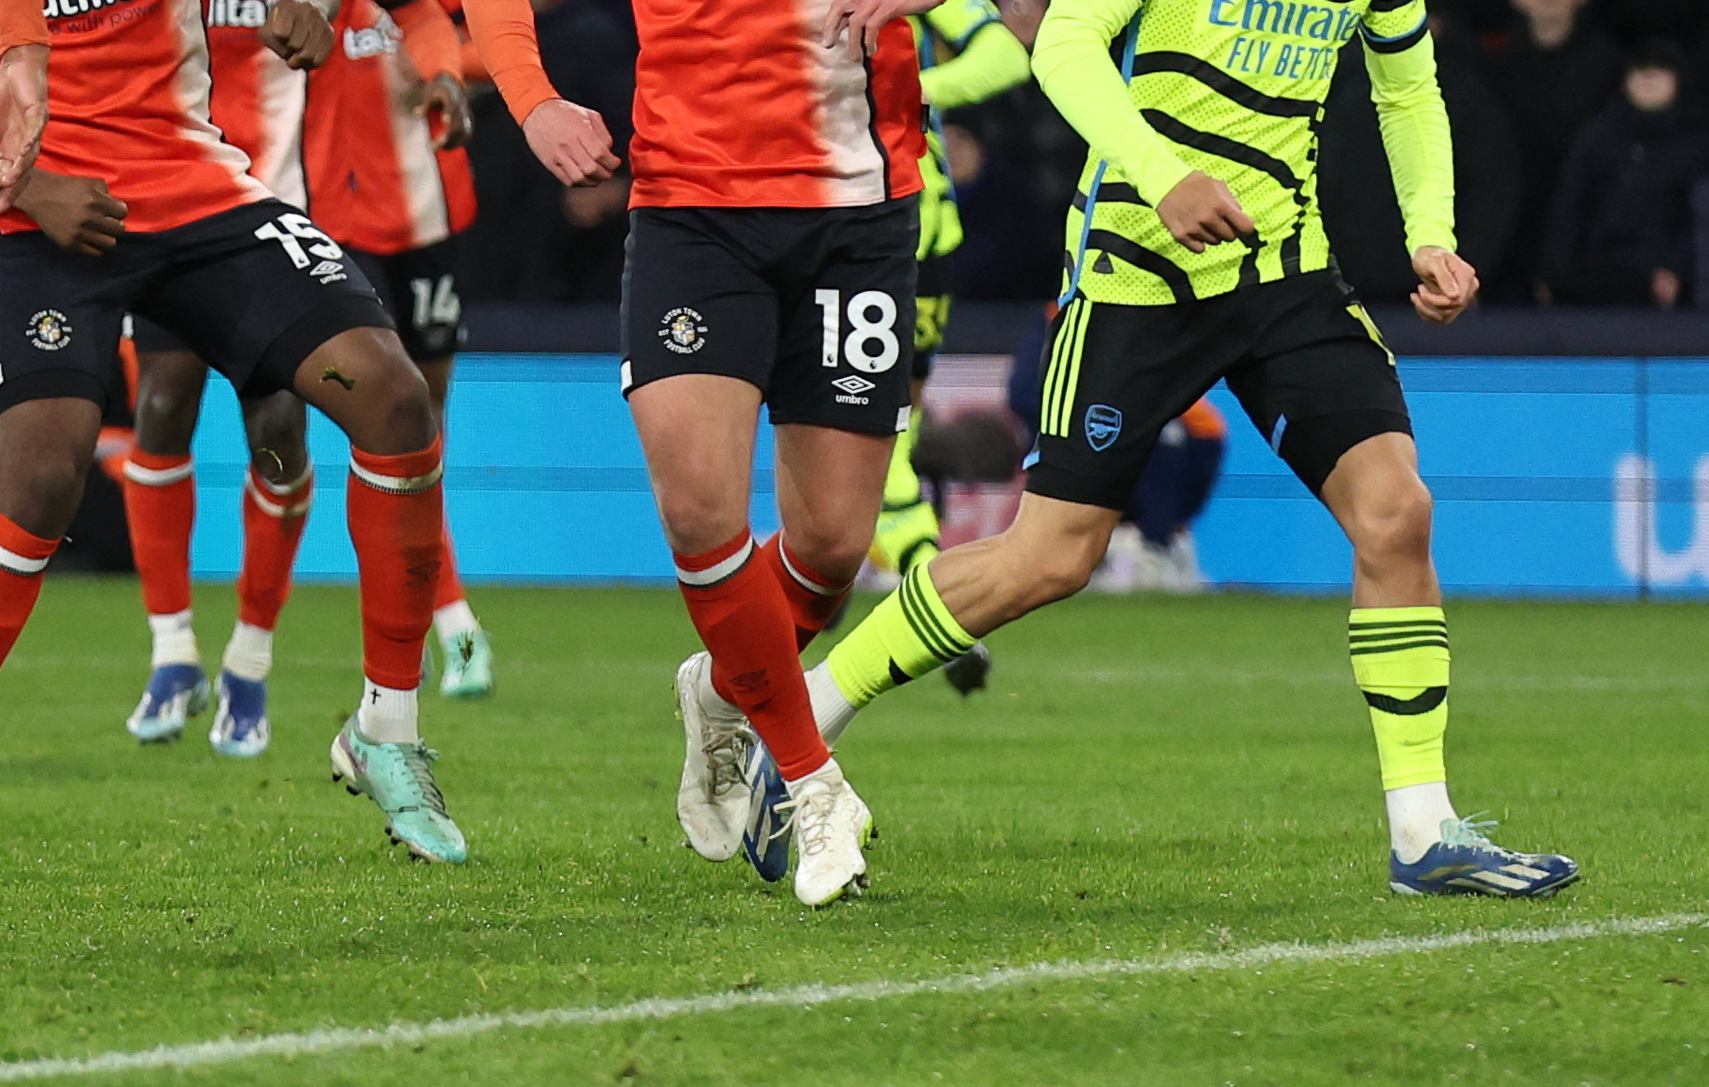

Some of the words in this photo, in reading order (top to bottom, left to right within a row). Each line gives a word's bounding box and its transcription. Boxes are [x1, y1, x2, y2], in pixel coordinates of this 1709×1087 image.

[1225, 36, 1272, 75] FLY
[253, 212, 344, 270] 15
[319, 272, 348, 285] umbro
[814, 288, 900, 374] 18
[835, 393, 869, 406] umbro
